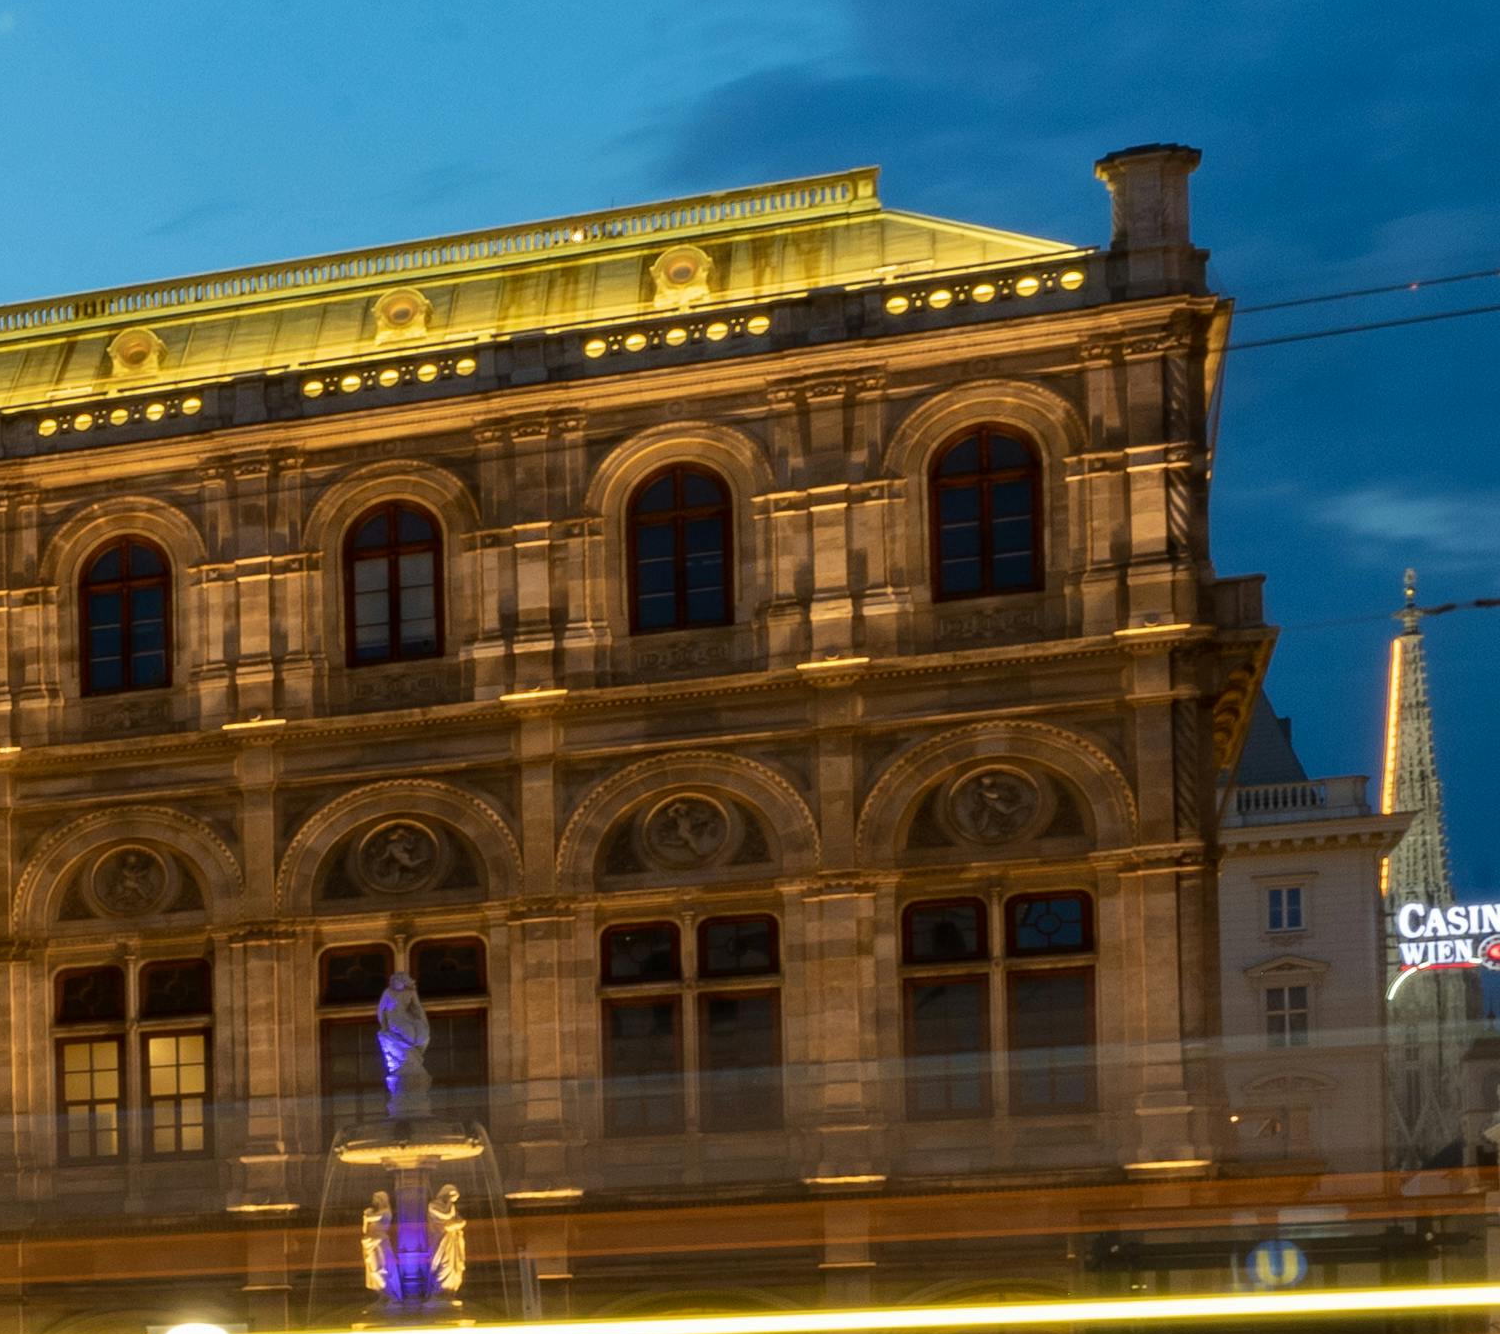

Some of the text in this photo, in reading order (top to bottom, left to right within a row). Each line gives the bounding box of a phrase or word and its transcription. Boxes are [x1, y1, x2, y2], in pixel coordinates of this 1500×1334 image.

[1399, 903, 1500, 939] CASIN
[1399, 938, 1474, 965] WIEN
[1255, 1248, 1299, 1286] U
